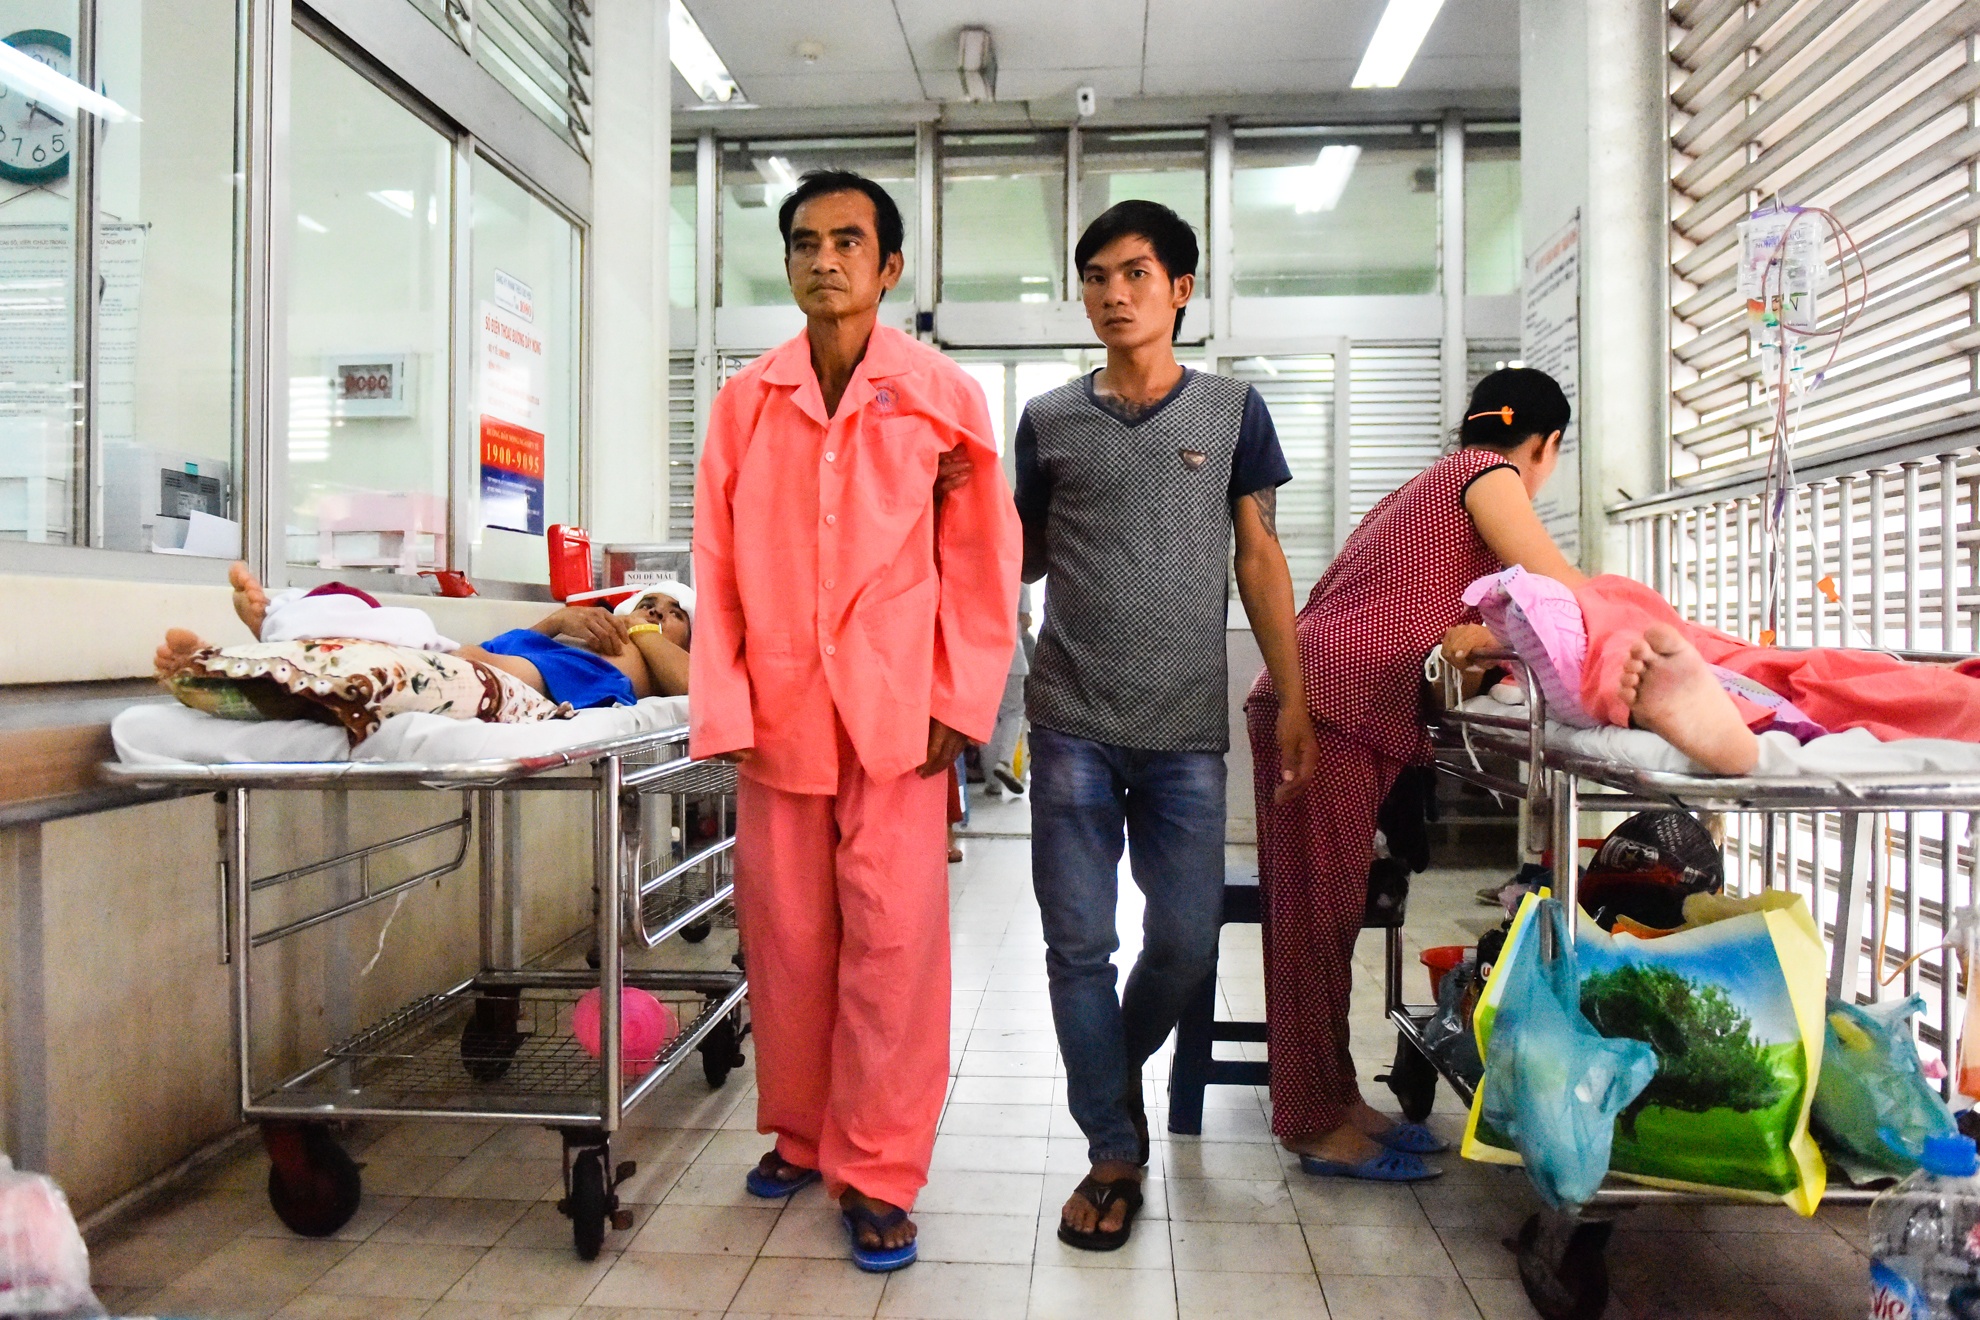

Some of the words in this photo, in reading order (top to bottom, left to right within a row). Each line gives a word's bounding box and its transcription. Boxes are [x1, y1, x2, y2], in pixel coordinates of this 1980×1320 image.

[11, 137, 23, 157] 7
[32, 144, 46, 162] 6
[52, 133, 65, 153] 5
[486, 442, 540, 474] 1900-9095
